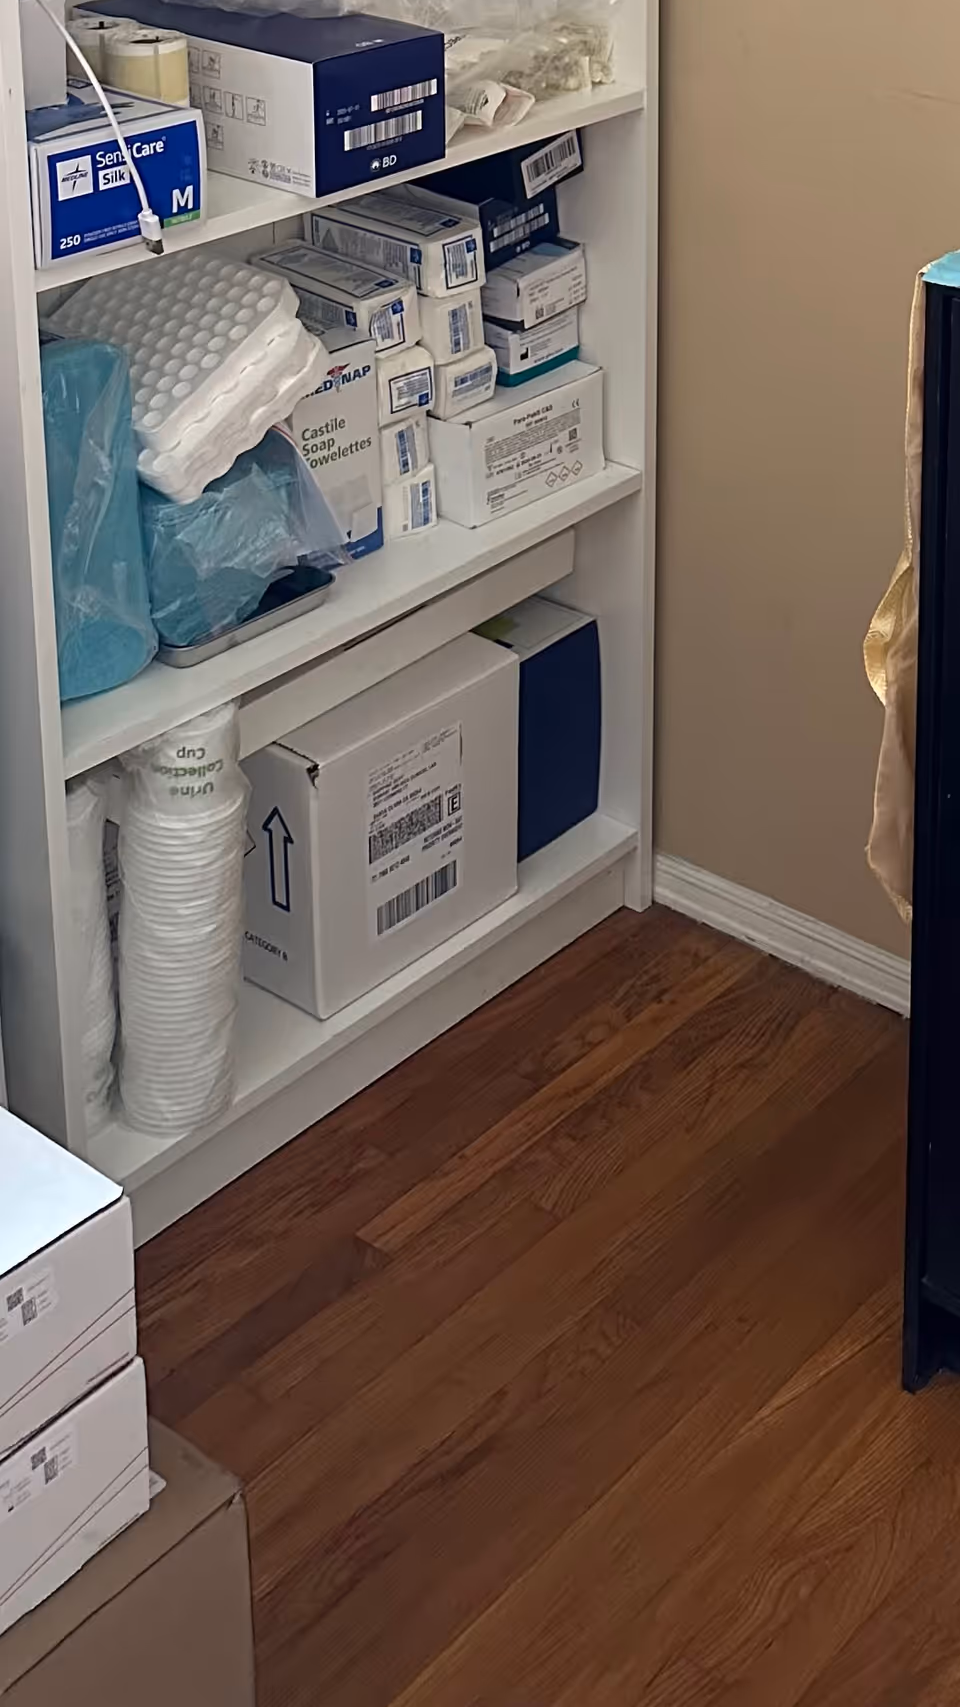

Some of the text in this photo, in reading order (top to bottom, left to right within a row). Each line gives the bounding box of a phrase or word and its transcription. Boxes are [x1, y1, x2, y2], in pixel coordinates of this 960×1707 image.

[382, 154, 397, 168] BD
[102, 169, 127, 186] Silk
[172, 184, 194, 214] M
[60, 234, 82, 250] 250
[301, 417, 346, 442] Castile
[302, 437, 335, 457] Soap
[176, 746, 206, 760] Cup
[451, 794, 459, 811] E
